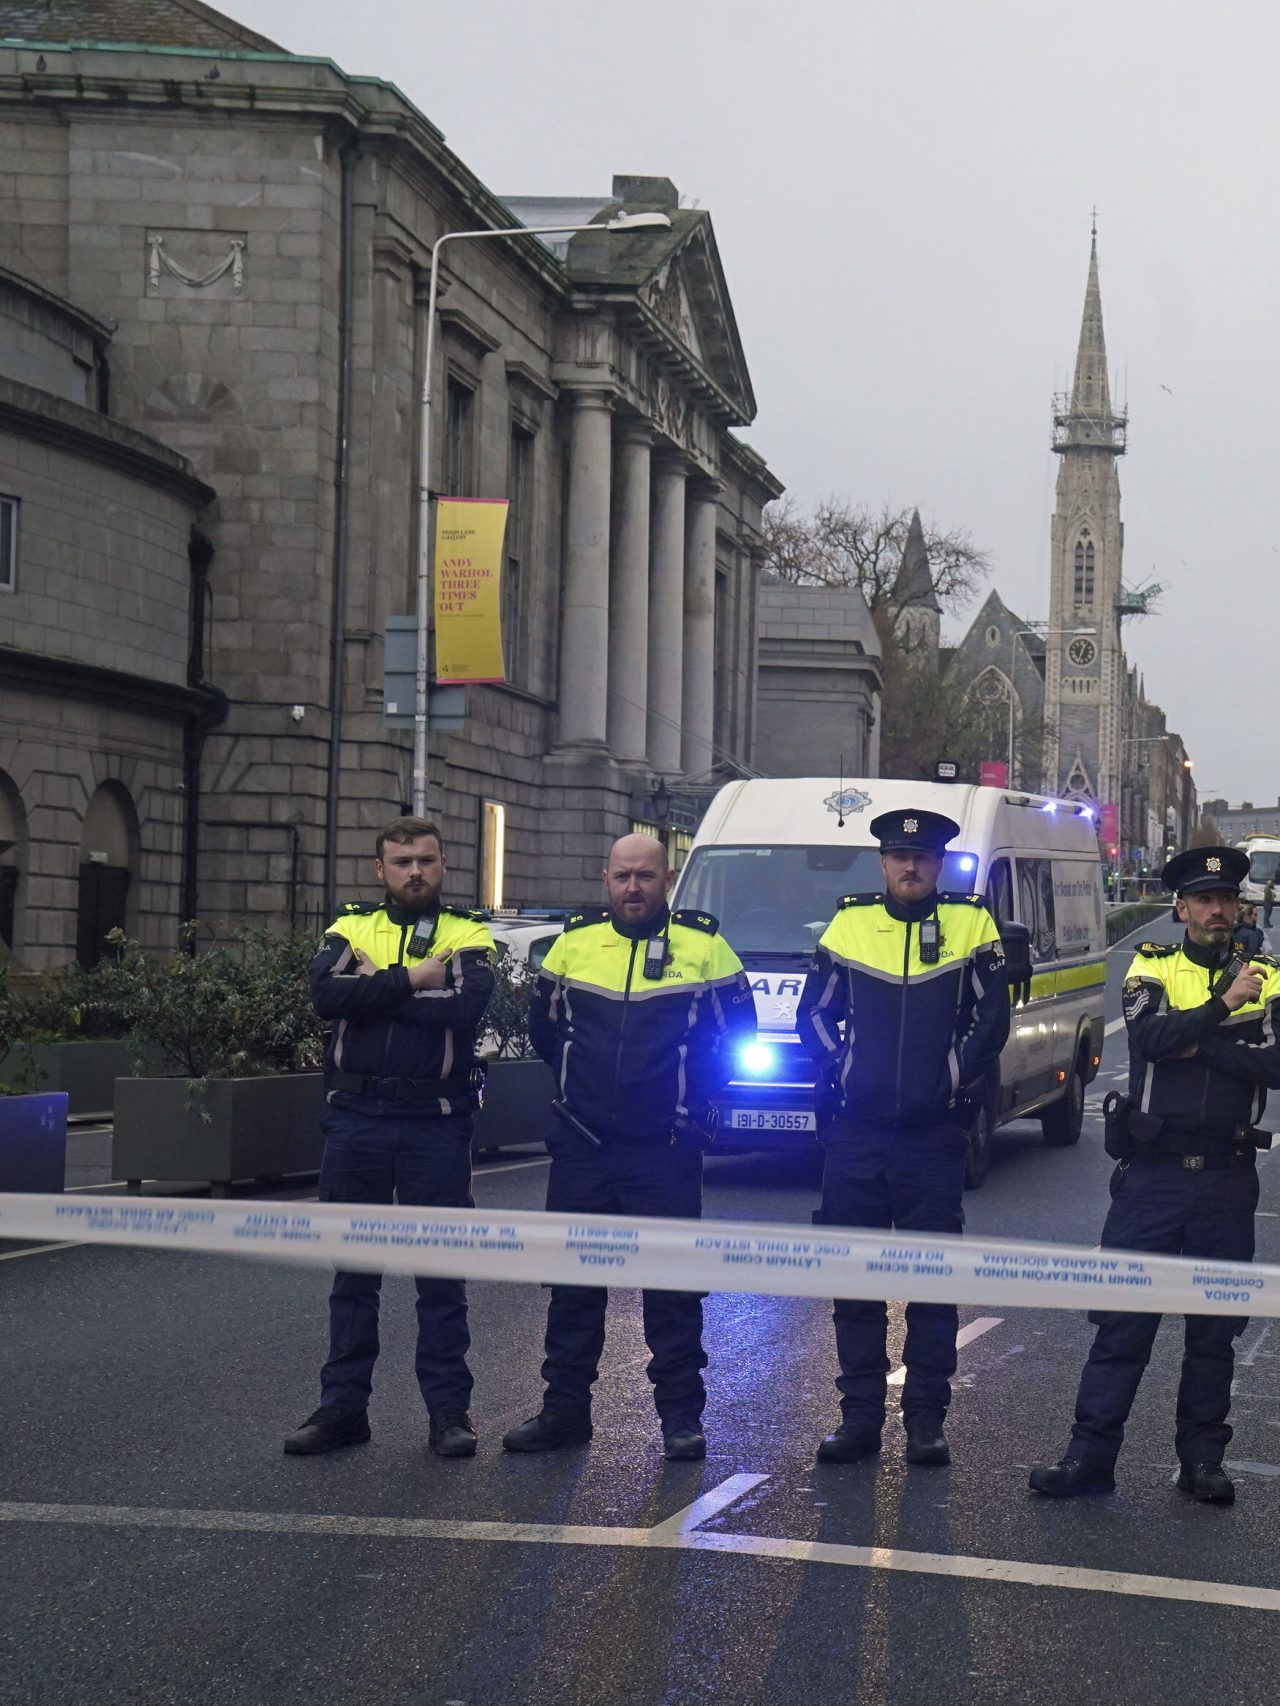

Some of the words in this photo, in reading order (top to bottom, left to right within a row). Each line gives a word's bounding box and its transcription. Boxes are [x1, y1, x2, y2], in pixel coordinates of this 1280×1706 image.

[442, 559, 472, 567] ANDY
[440, 569, 493, 578] WARHOL
[440, 580, 480, 589] THREE
[440, 591, 477, 600] TIMES
[439, 602, 465, 612] OUT
[737, 1112, 809, 1129] 191-D-30557
[565, 1241, 640, 1254] Confidential
[695, 1238, 752, 1251] ISTEACH
[758, 1240, 790, 1252] DHUL
[792, 1242, 810, 1254] AR
[815, 1244, 850, 1257] COSC
[723, 1253, 762, 1265] COIRE
[880, 1248, 922, 1260] ENTRY
[926, 1250, 945, 1262] NO
[579, 1255, 625, 1267] GARDA
[866, 1261, 909, 1273] SCENE
[1052, 1258, 1098, 1271] GARDA
[1100, 1260, 1118, 1272] AN
[912, 1264, 953, 1276] CRIME
[1108, 1275, 1152, 1287] UIMHIR
[1193, 1276, 1264, 1290] Confidential
[1205, 1290, 1250, 1302] GARDA
